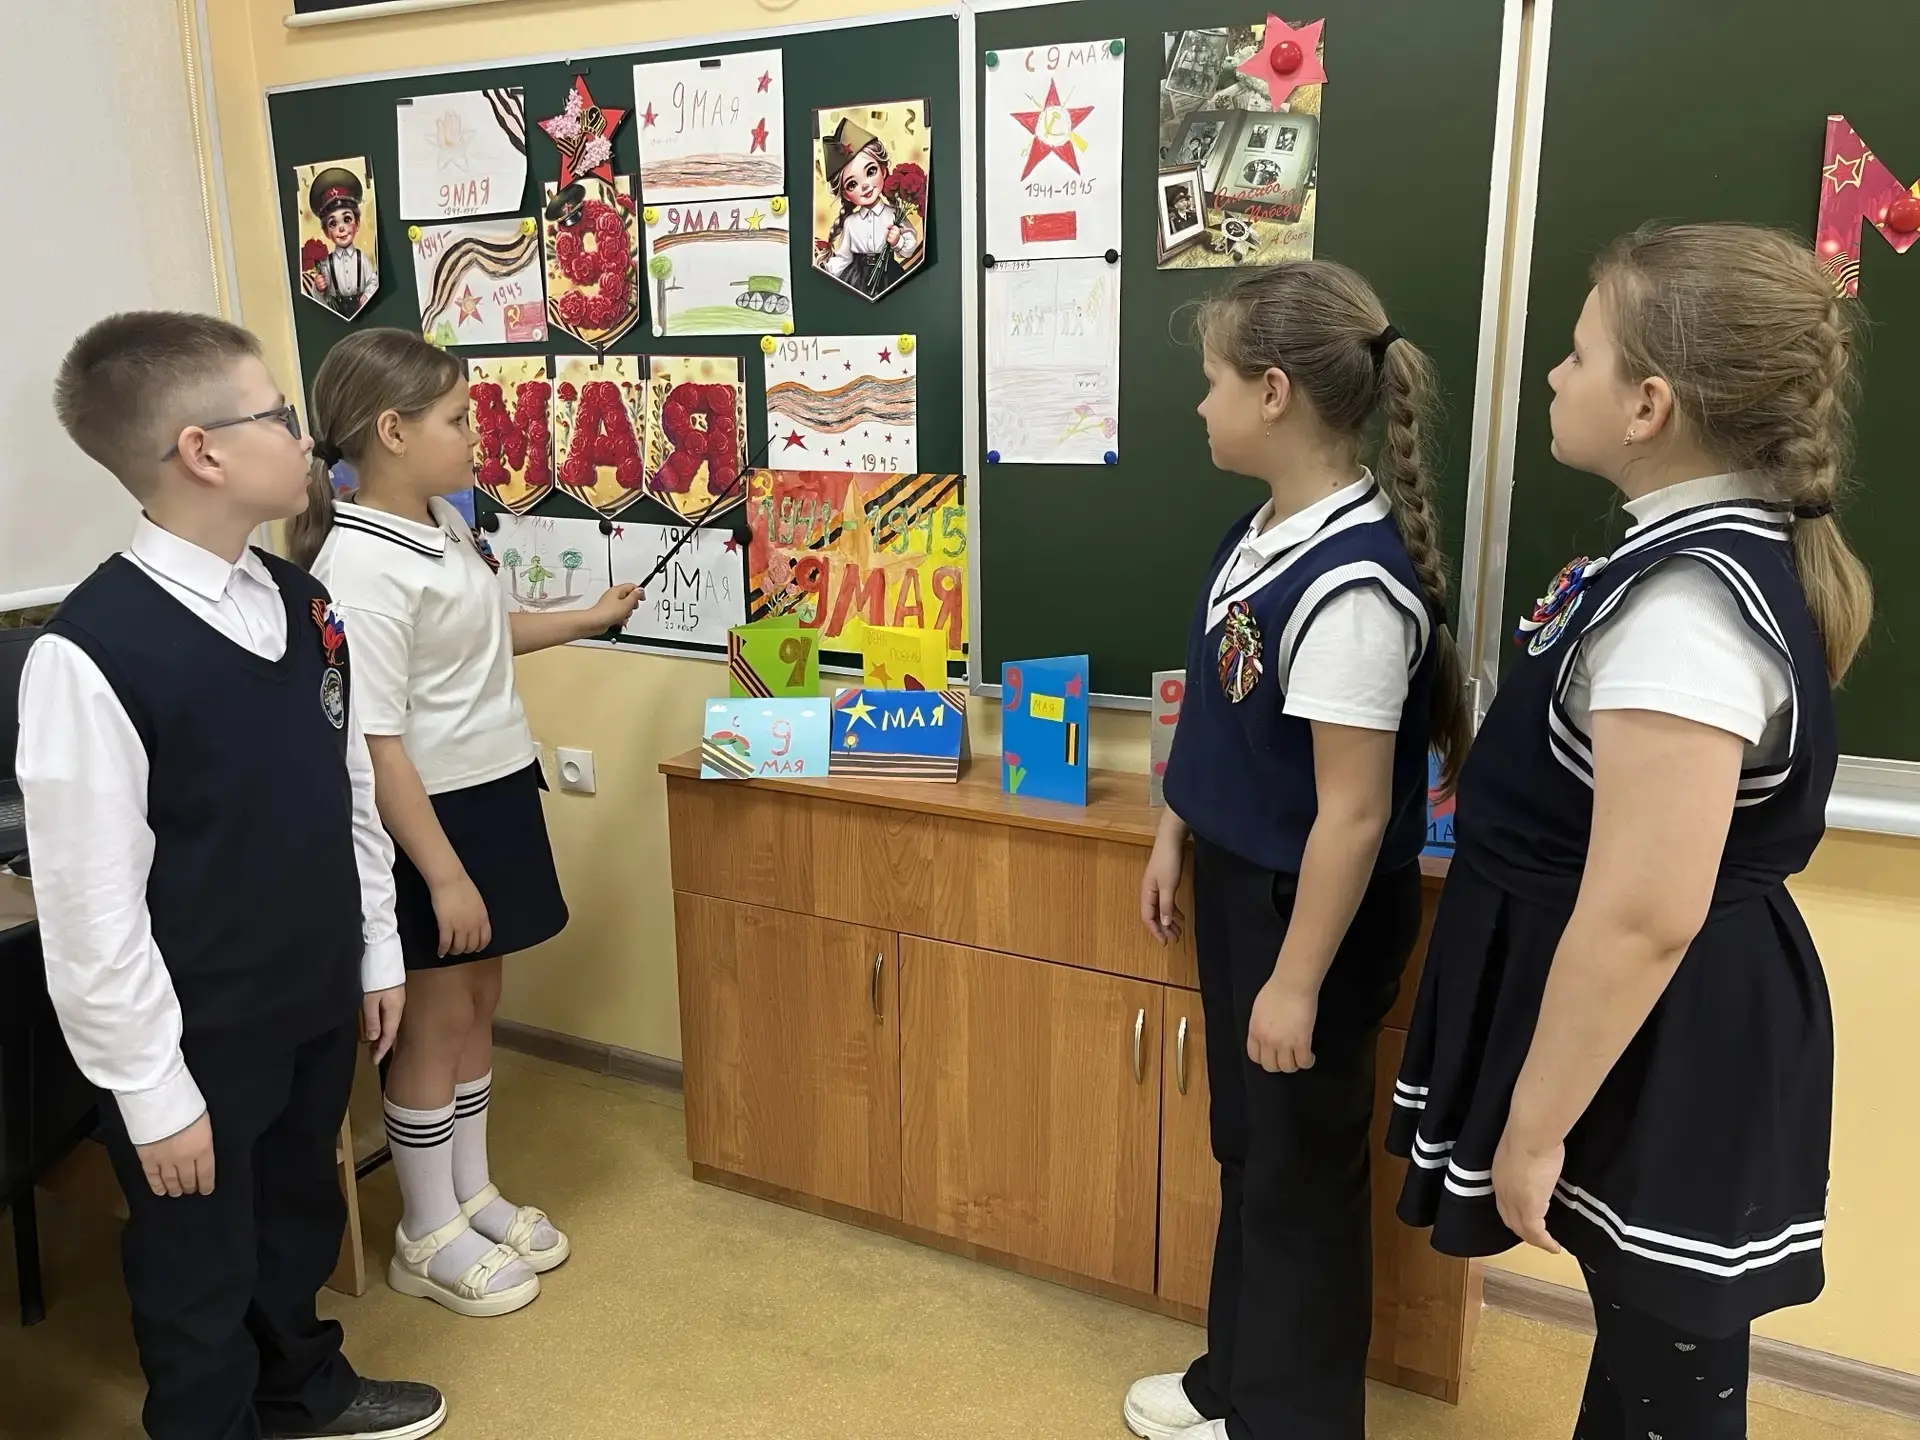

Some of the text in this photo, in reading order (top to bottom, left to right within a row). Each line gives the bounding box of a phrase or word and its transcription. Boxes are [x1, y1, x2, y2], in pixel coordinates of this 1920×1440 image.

[1047, 46, 1060, 70] 9
[1067, 42, 1110, 67] МАЯ
[1025, 178, 1097, 198] 1941-1945
[1213, 179, 1280, 213] Спасибо
[556, 200, 632, 329] 9
[492, 283, 523, 306] 1945
[469, 380, 740, 496] МАЯ
[861, 453, 898, 472] 1945
[654, 599, 699, 629] 1945
[881, 704, 944, 731] МАЯ
[1033, 699, 1055, 714] МАЯ
[771, 719, 792, 756] 9
[759, 759, 804, 774] МАЯ
